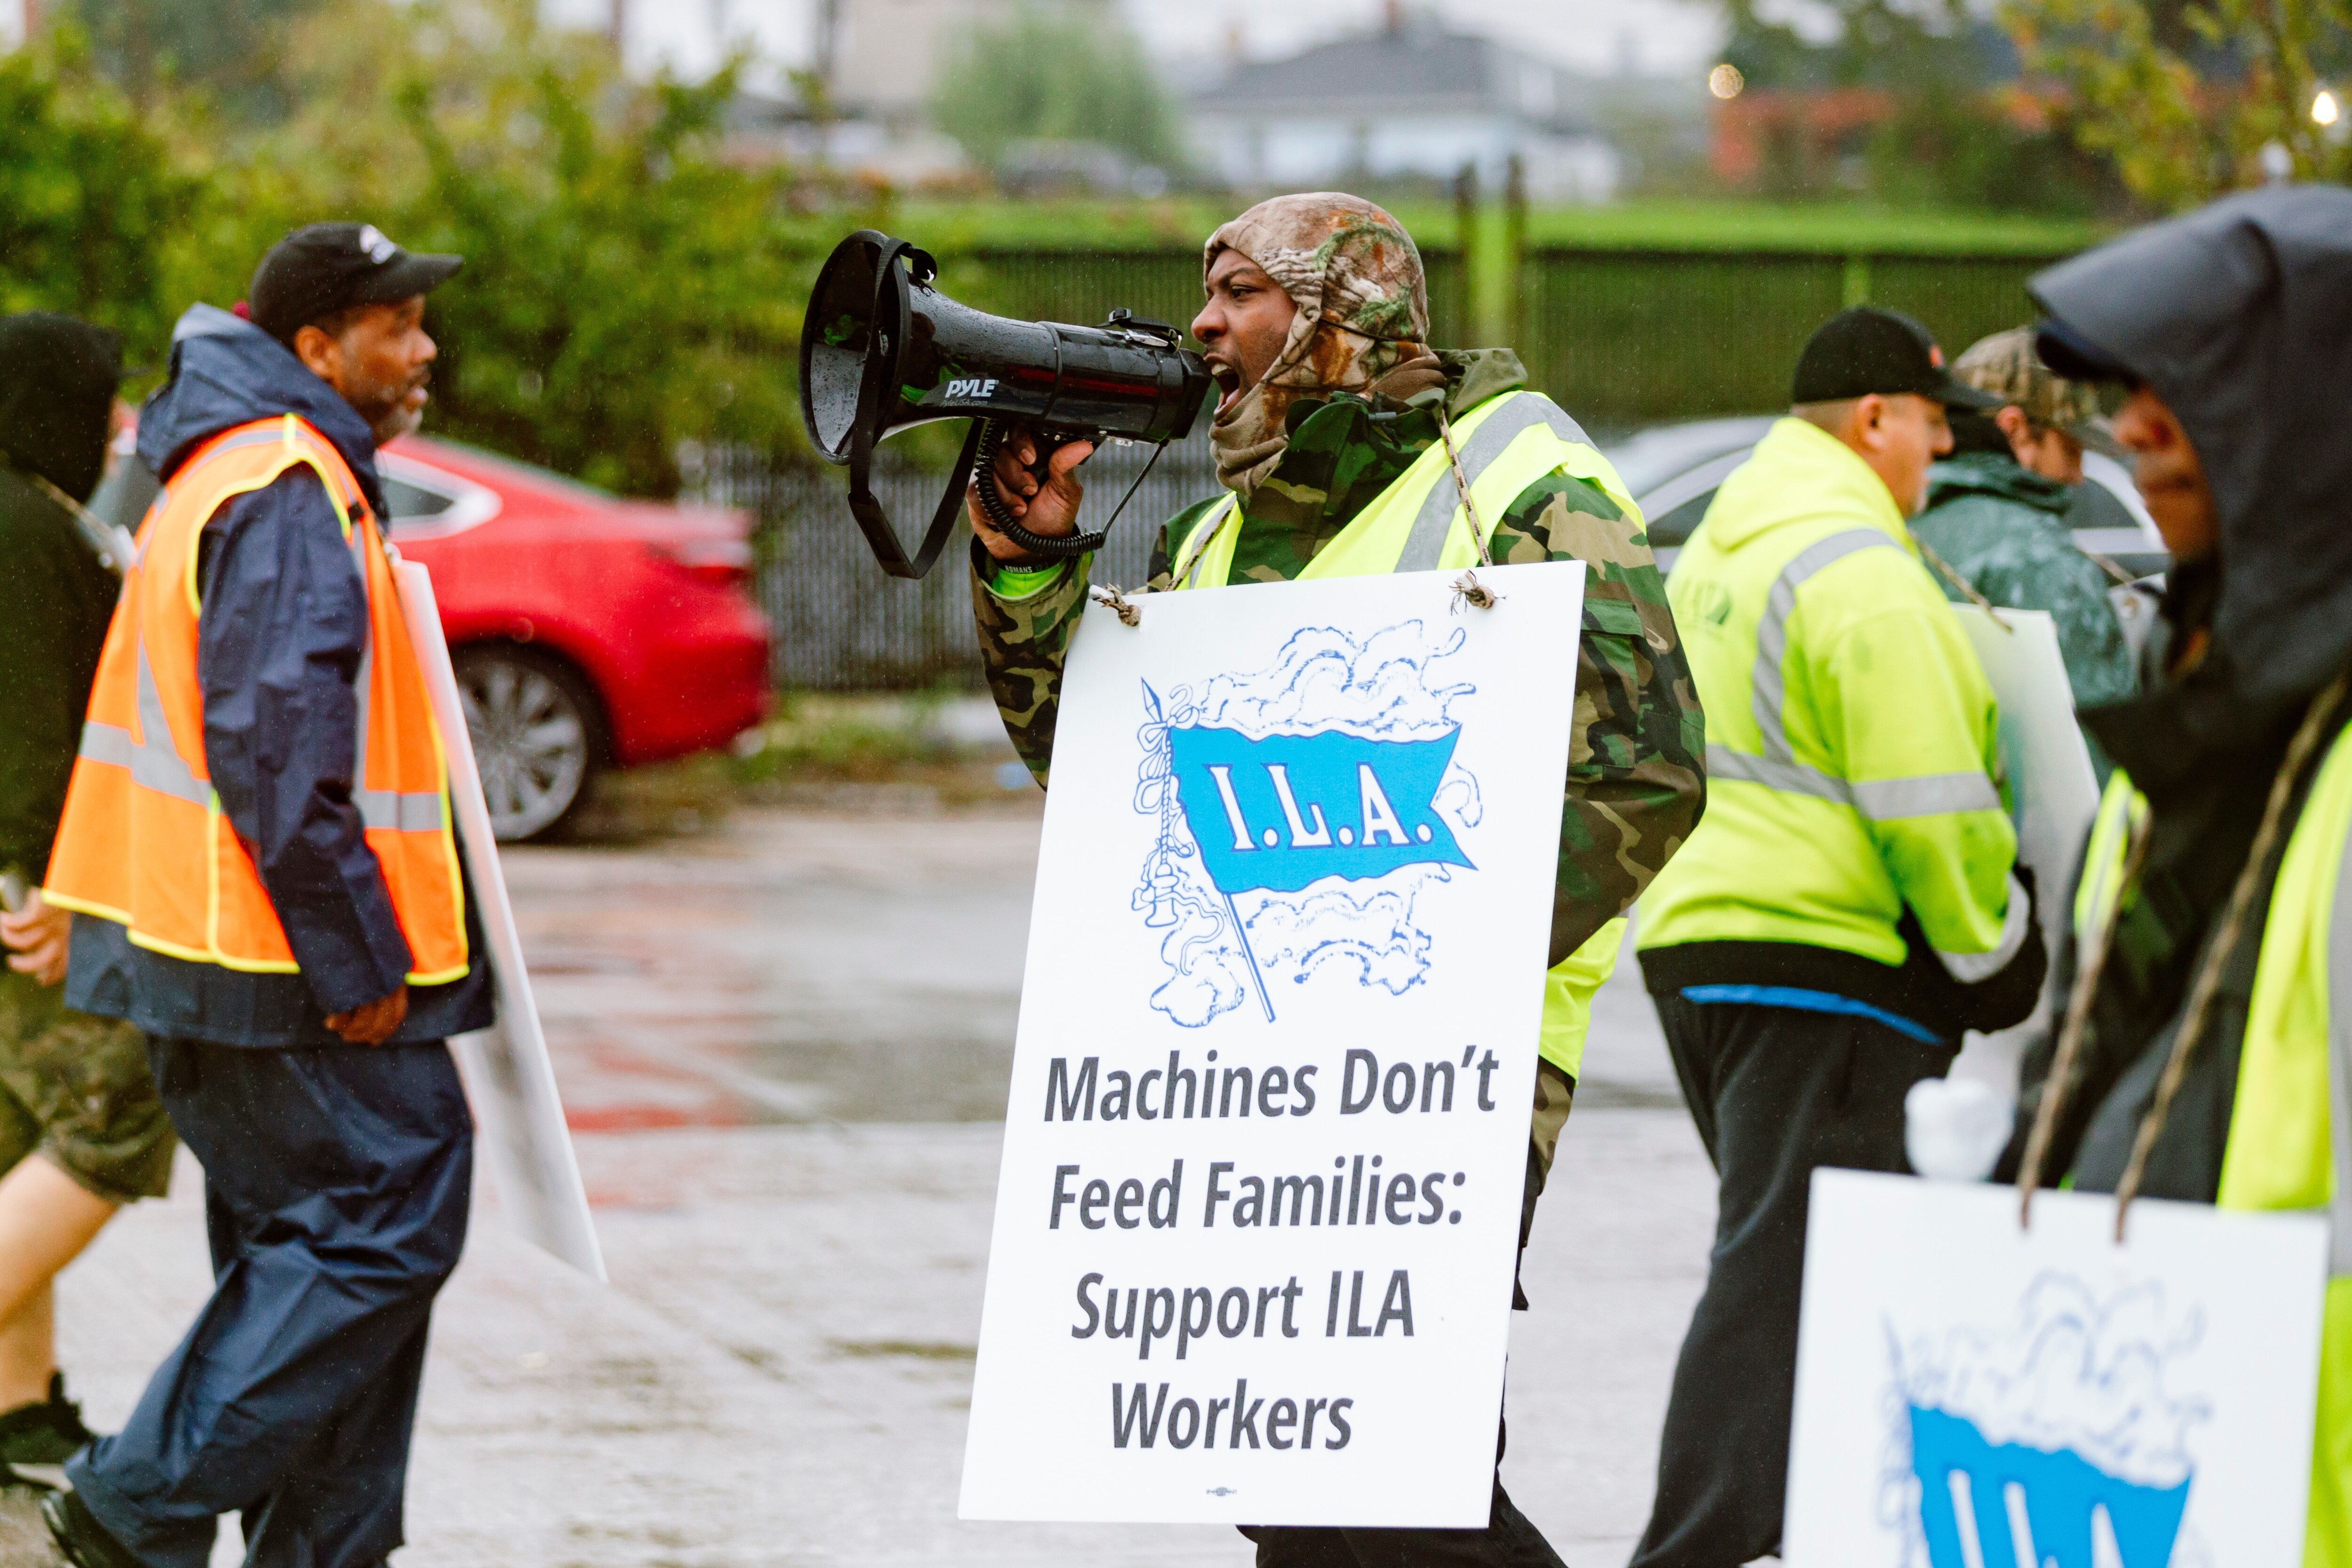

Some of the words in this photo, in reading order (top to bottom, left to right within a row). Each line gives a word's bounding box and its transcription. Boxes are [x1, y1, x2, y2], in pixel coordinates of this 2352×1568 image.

[945, 379, 996, 398] PYLE
[1005, 565, 1033, 573] ROMANS
[1204, 762, 1433, 852] I.L.A.
[1044, 1050, 1318, 1122] Machines
[1049, 1159, 1184, 1230] Feed
[1203, 1155, 1466, 1228] Families:
[1071, 1273, 1303, 1360] Support
[1325, 1270, 1414, 1337] ILA
[1112, 1378, 1353, 1450] Workers
